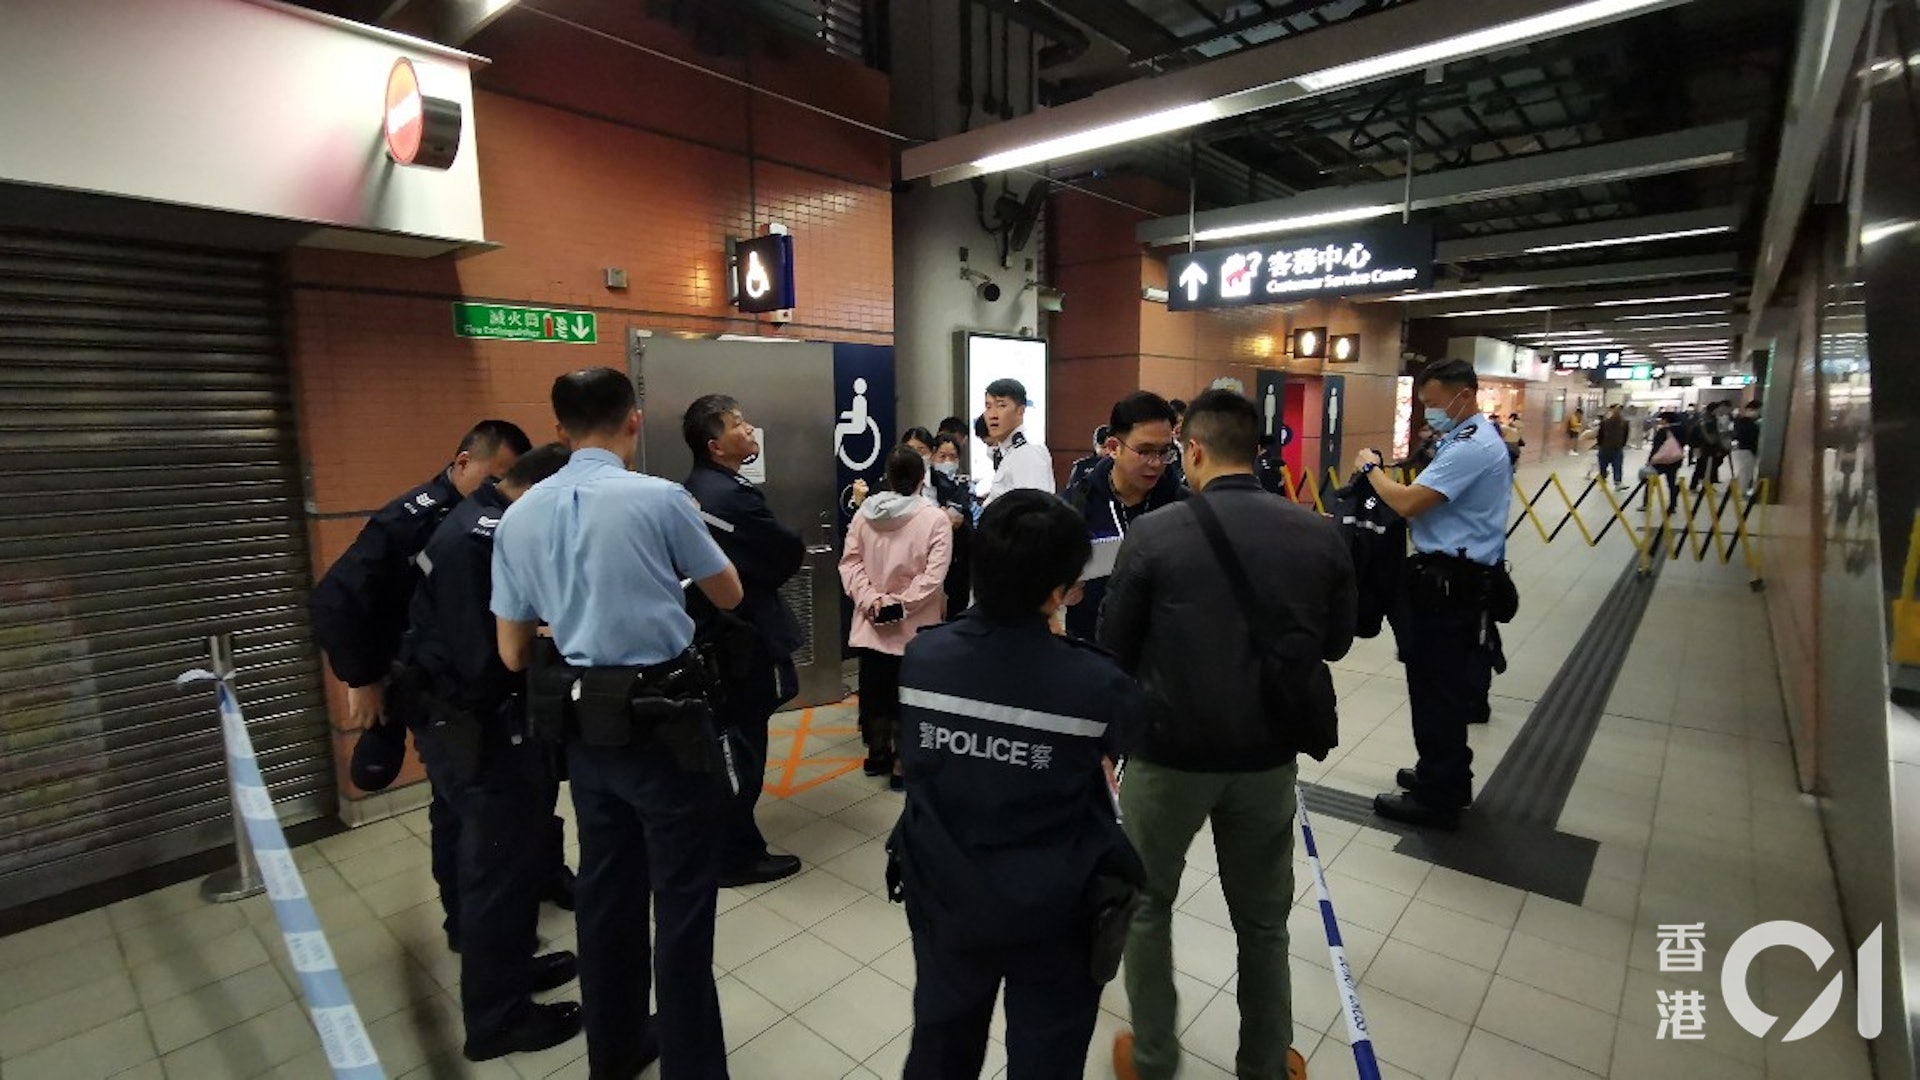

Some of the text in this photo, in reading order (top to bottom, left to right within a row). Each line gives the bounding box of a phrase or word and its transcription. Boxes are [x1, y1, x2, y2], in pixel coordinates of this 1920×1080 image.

[1267, 242, 1371, 277] 客務中心
[1266, 267, 1418, 294] Customer Service Centre
[464, 324, 541, 338] Fire Extinguisher
